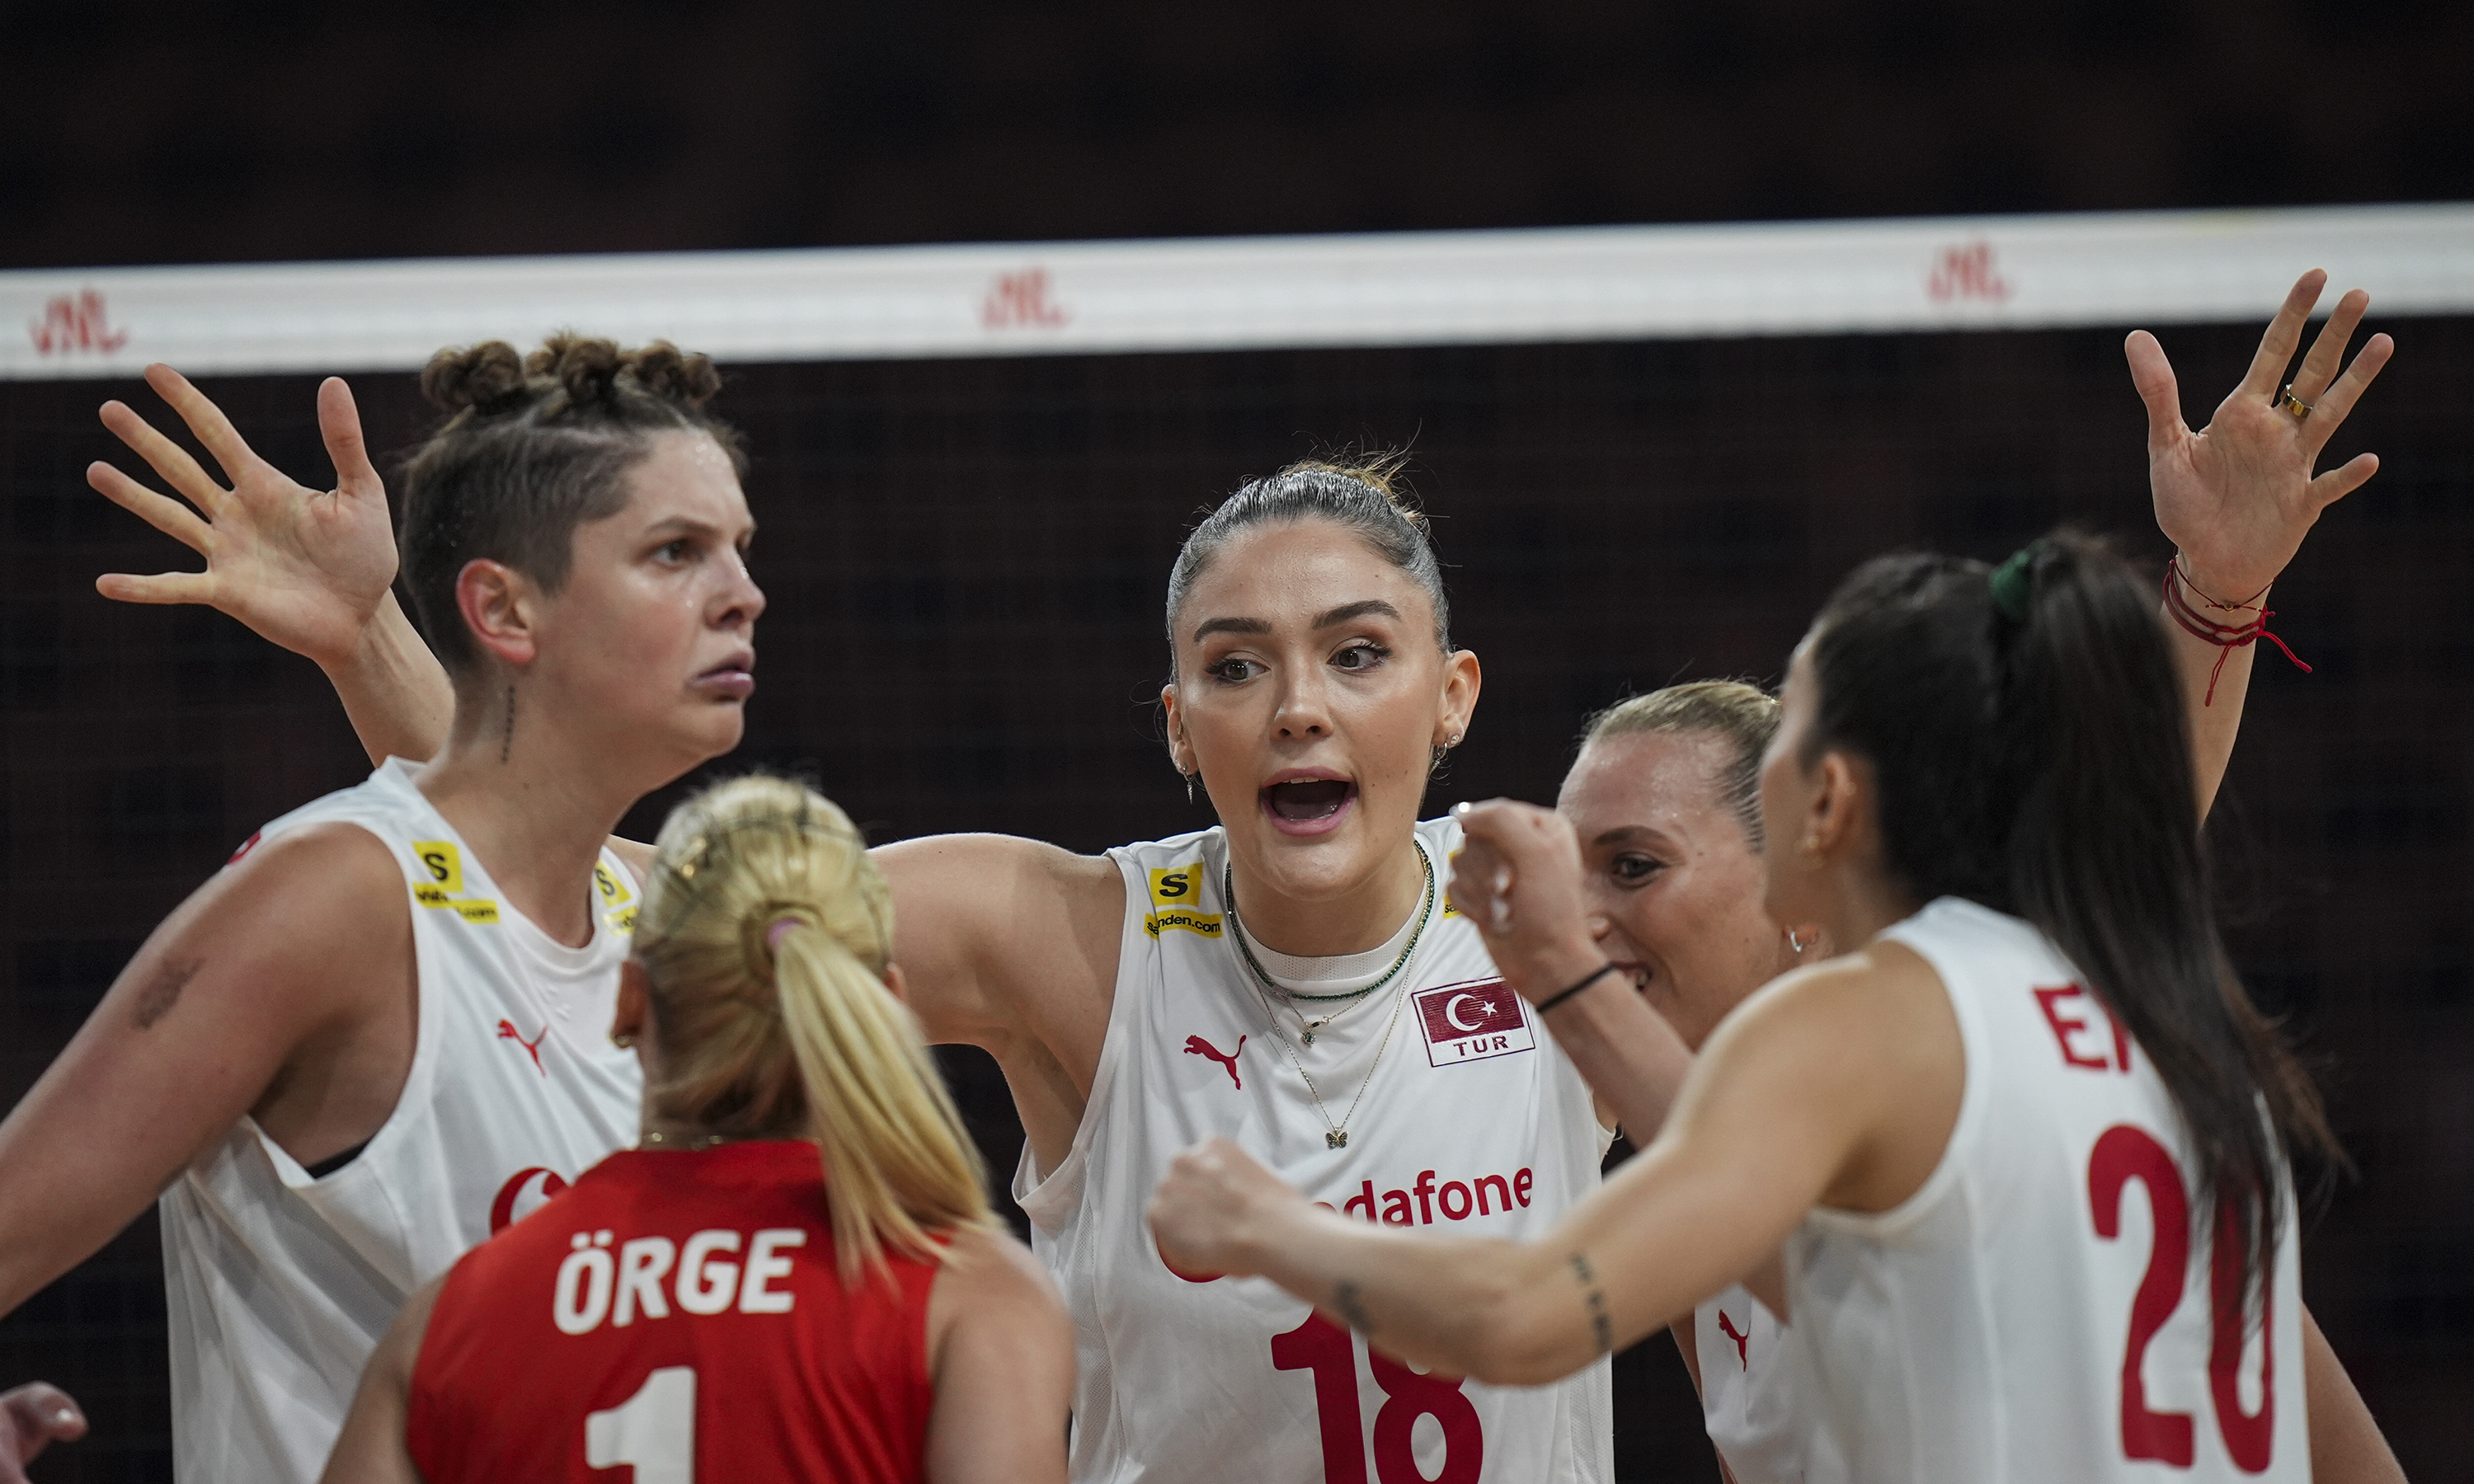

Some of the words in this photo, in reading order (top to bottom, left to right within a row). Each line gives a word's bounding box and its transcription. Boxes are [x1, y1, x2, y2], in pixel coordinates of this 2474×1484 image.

[1159, 873, 1188, 898] S
[1453, 1035, 1509, 1057] TUR
[553, 1228, 807, 1336] ÖRGE
[2088, 1124, 2274, 1473] 20
[585, 1364, 698, 1484] 1
[1271, 1304, 1484, 1484] 18
